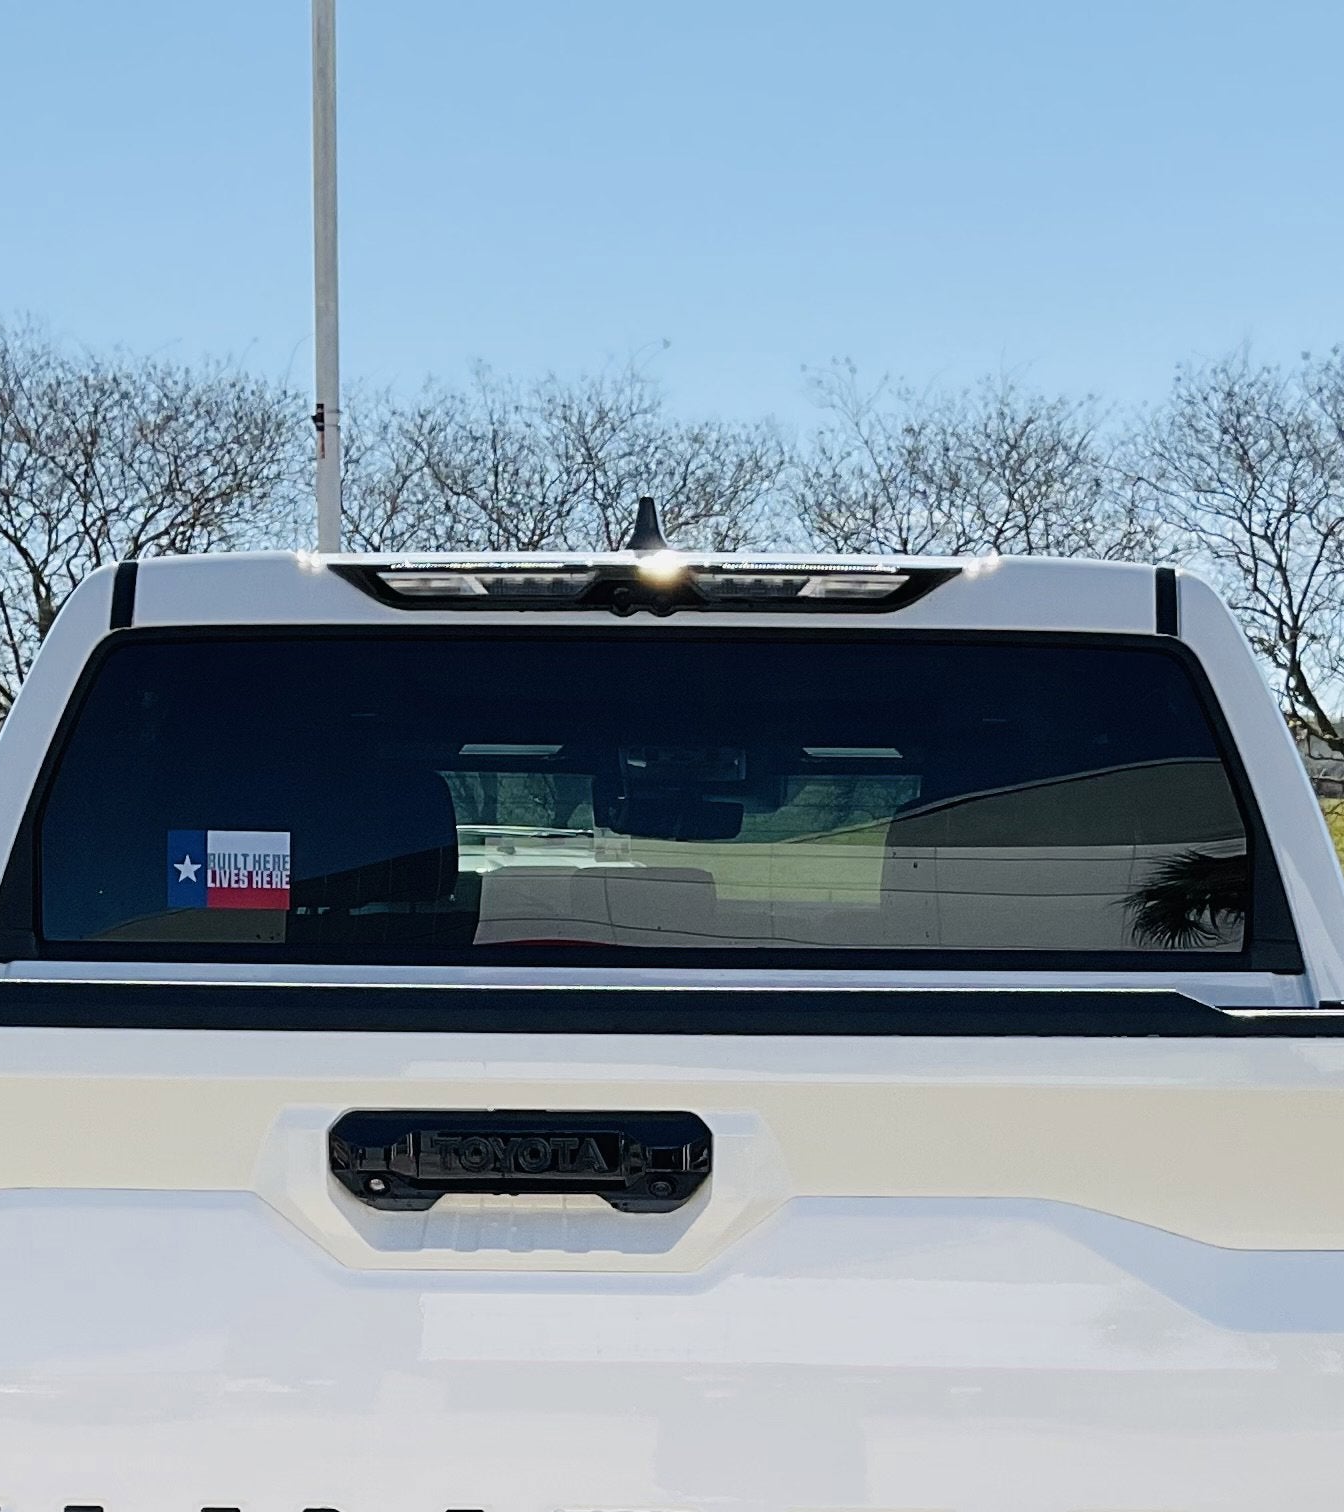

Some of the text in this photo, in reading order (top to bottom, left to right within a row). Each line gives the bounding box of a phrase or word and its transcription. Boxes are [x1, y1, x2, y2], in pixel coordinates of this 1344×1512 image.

[208, 853, 290, 871] BUILT HERE
[208, 869, 290, 889] LIVES HERE
[433, 1136, 609, 1172] TOYOTA
